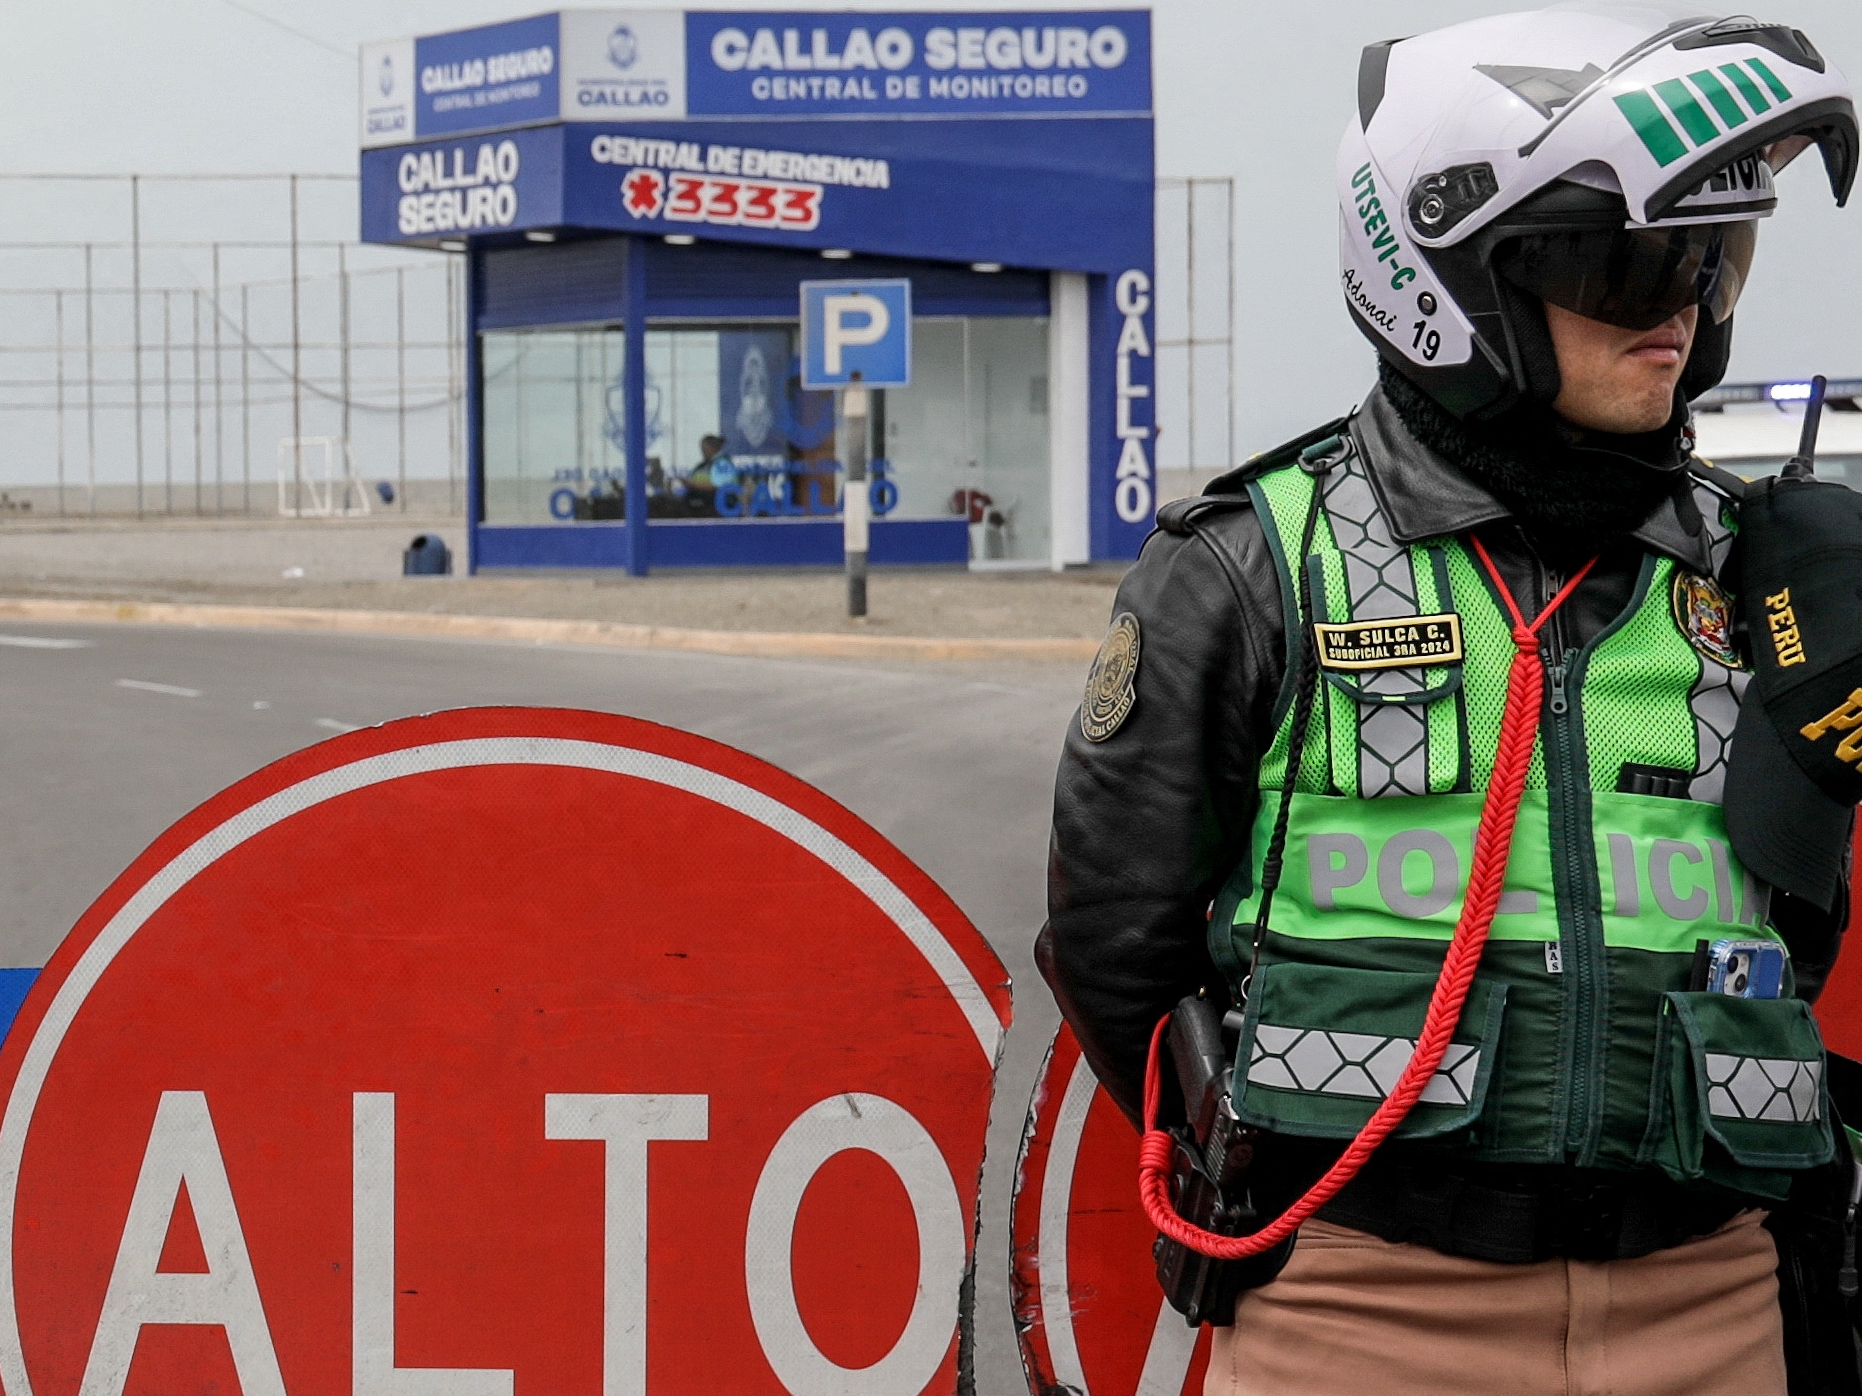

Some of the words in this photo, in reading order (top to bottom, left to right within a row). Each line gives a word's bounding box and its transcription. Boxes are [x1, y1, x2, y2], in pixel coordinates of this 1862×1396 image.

[711, 27, 913, 71] CALLAO
[924, 25, 1128, 70] SEGURO
[578, 89, 669, 108] CALLAO
[752, 76, 876, 101] CENTRAL
[885, 76, 921, 99] DE
[929, 75, 1087, 99] MONITOREO
[398, 140, 520, 193] CALLAO
[591, 135, 706, 174] CENTRAL
[707, 147, 741, 176] DE
[741, 148, 890, 190] EMERGENCIA
[398, 183, 518, 235] SEGURO
[1351, 162, 1416, 290] UTSEVI-C
[1342, 269, 1398, 331] Adonai
[823, 293, 891, 376] P
[1411, 319, 1441, 361] 19
[1115, 269, 1152, 524] CALLAO
[713, 477, 900, 517] CALLO
[1328, 632, 1353, 647] W.
[1360, 626, 1420, 646] SULCA
[1427, 624, 1445, 640] C.
[1328, 646, 1390, 660] SUBOFICIAL
[1393, 643, 1417, 657] 3RA
[1420, 640, 1451, 654] 2024
[1765, 586, 1808, 668] PERU
